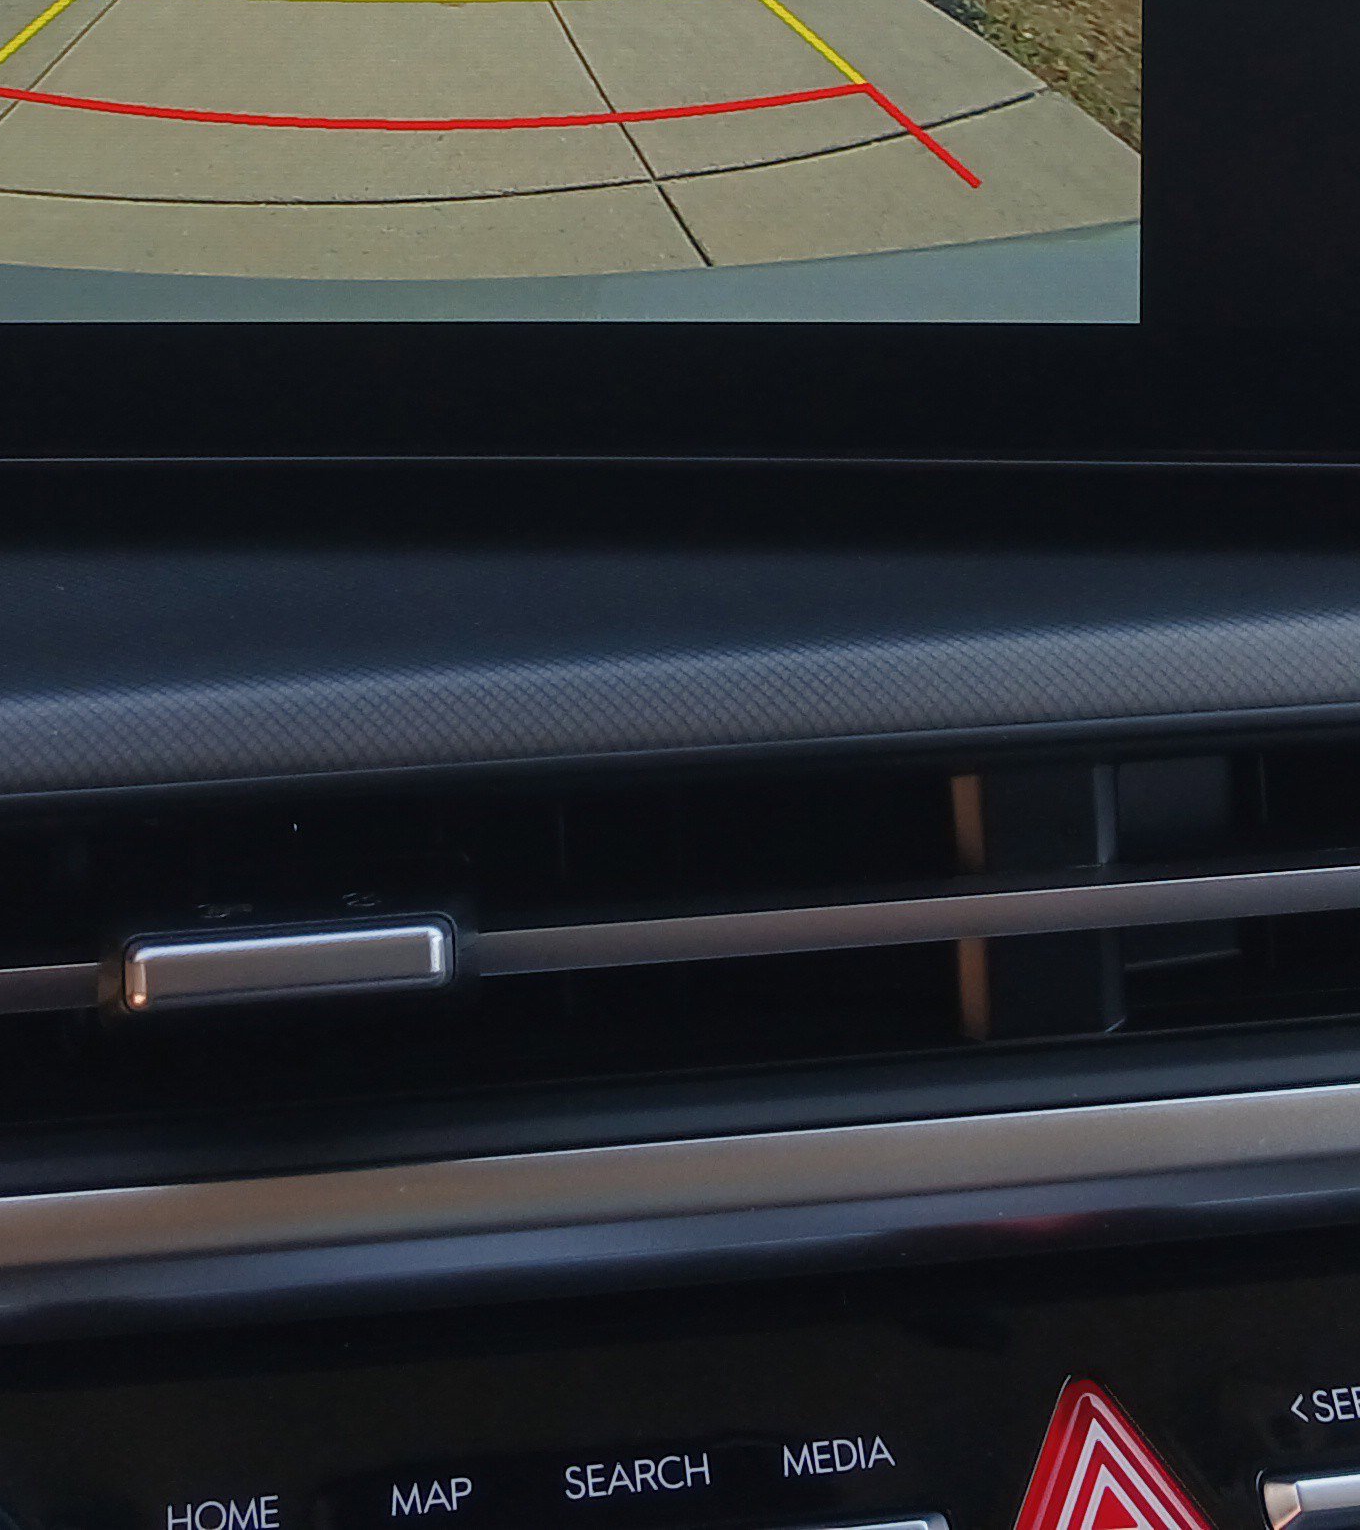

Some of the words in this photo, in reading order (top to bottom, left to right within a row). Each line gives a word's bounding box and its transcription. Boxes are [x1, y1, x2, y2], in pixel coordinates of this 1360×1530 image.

[564, 1452, 712, 1501] SEARCH
[782, 1435, 896, 1478] MEDIA
[166, 1494, 281, 1530] HOME
[390, 1476, 473, 1517] MAP
